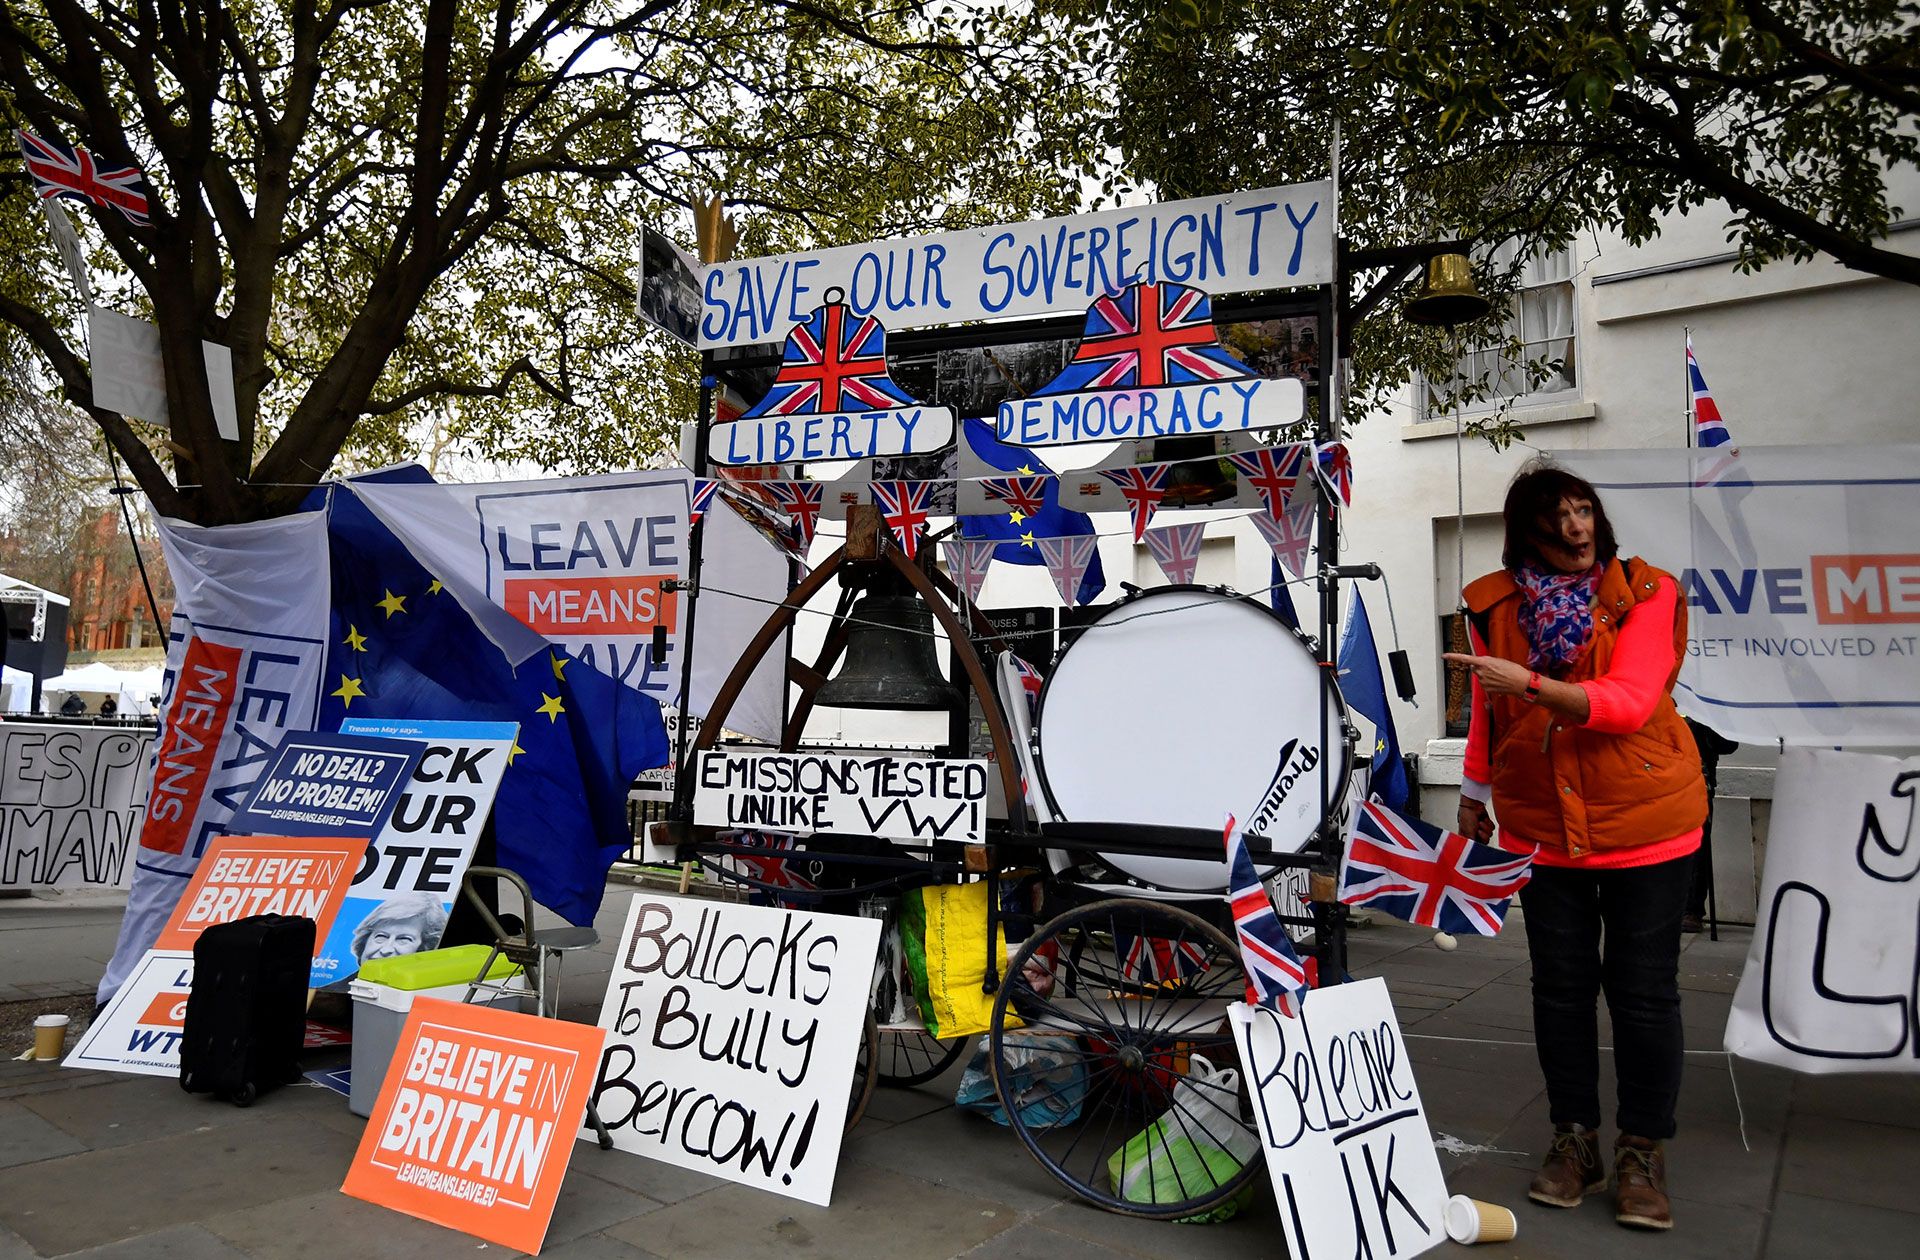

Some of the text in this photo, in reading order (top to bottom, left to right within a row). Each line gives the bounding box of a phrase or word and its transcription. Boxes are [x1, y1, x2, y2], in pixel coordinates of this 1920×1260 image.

[702, 201, 1318, 342] SAVE OUR SOVEREIGNTY
[999, 380, 1262, 443] DEMOCRACY
[728, 409, 921, 464] LIBERTY
[497, 514, 678, 571] LEAVE
[528, 588, 656, 624] MEANS
[1685, 636, 1918, 657] GET INVOLVED AT
[152, 664, 228, 823] MEANS
[348, 725, 380, 734] Treason
[381, 727, 398, 735] May
[291, 752, 386, 783] NO DEAL?
[701, 753, 987, 800] EMISSIONS TESTED
[260, 778, 386, 814] NO PROBLEM!
[270, 808, 347, 827] LEAVEMEANSLEAVE.EU
[727, 794, 978, 840] UNLIKE VW!
[0, 808, 136, 885] MAN
[207, 857, 342, 886] BELIEVE IN
[186, 886, 329, 923] BRITAIN
[127, 1029, 183, 1055] WT
[614, 980, 819, 1088] To Bully
[405, 1036, 571, 1114] BELIEVE IN
[380, 1087, 553, 1190] BRITAIN
[396, 1161, 499, 1208] LEAVEMEANSLEAVE.EU
